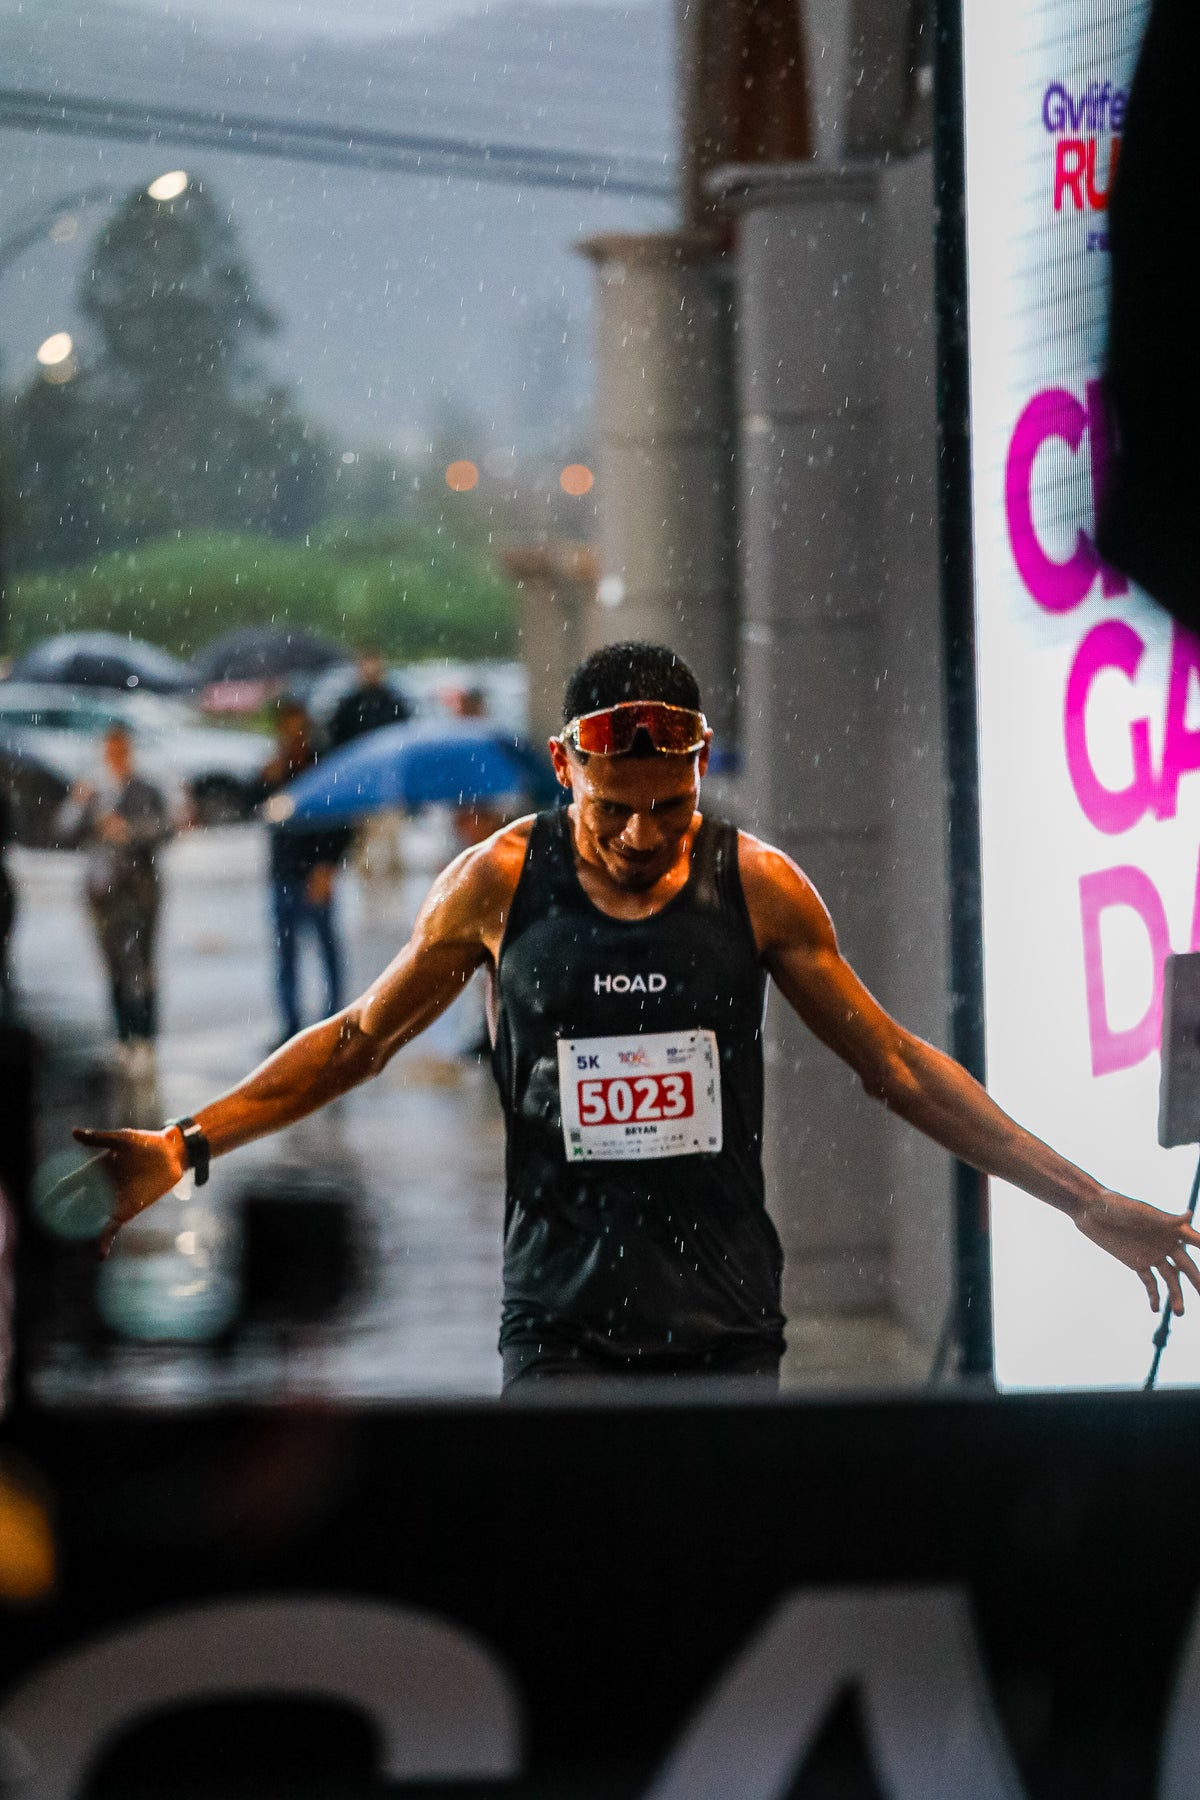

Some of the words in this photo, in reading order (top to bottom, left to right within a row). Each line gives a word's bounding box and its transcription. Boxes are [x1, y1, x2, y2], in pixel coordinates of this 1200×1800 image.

[1005, 380, 1130, 614] C
[1079, 845, 1200, 1077] D
[594, 973, 667, 993] HOAD
[577, 1055, 600, 1070] 5K
[581, 1075, 687, 1124] 5023
[625, 1125, 658, 1136] BRYAN
